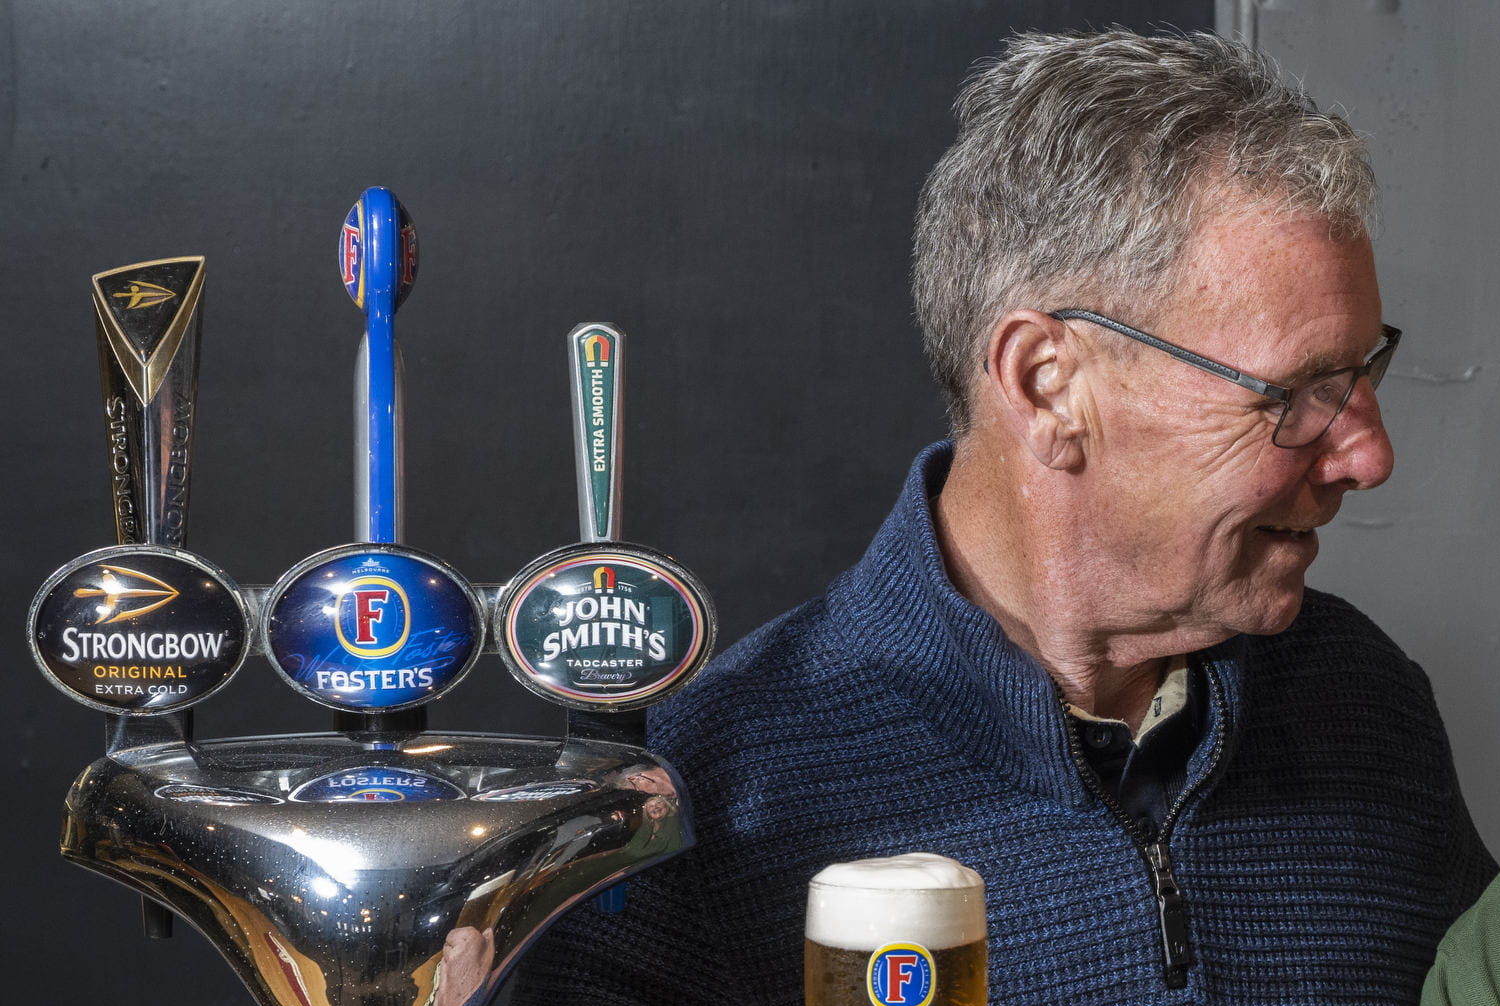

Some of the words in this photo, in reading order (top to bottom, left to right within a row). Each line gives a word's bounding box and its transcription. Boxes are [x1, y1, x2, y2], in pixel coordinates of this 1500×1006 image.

[591, 368, 604, 426] SMOOTH
[593, 428, 606, 473] EXTRA
[353, 589, 389, 644] F
[558, 596, 646, 626] JOHN
[61, 626, 224, 662] STRONGBOW
[542, 622, 667, 662] SMITH'S
[93, 665, 188, 679] ORIGINAL
[315, 667, 434, 690] FOSTER'S
[566, 659, 643, 667] TADCASTER
[580, 667, 632, 683] Brewery
[95, 684, 144, 695] EXTRA
[148, 684, 188, 695] COLD
[885, 954, 918, 1003] F
